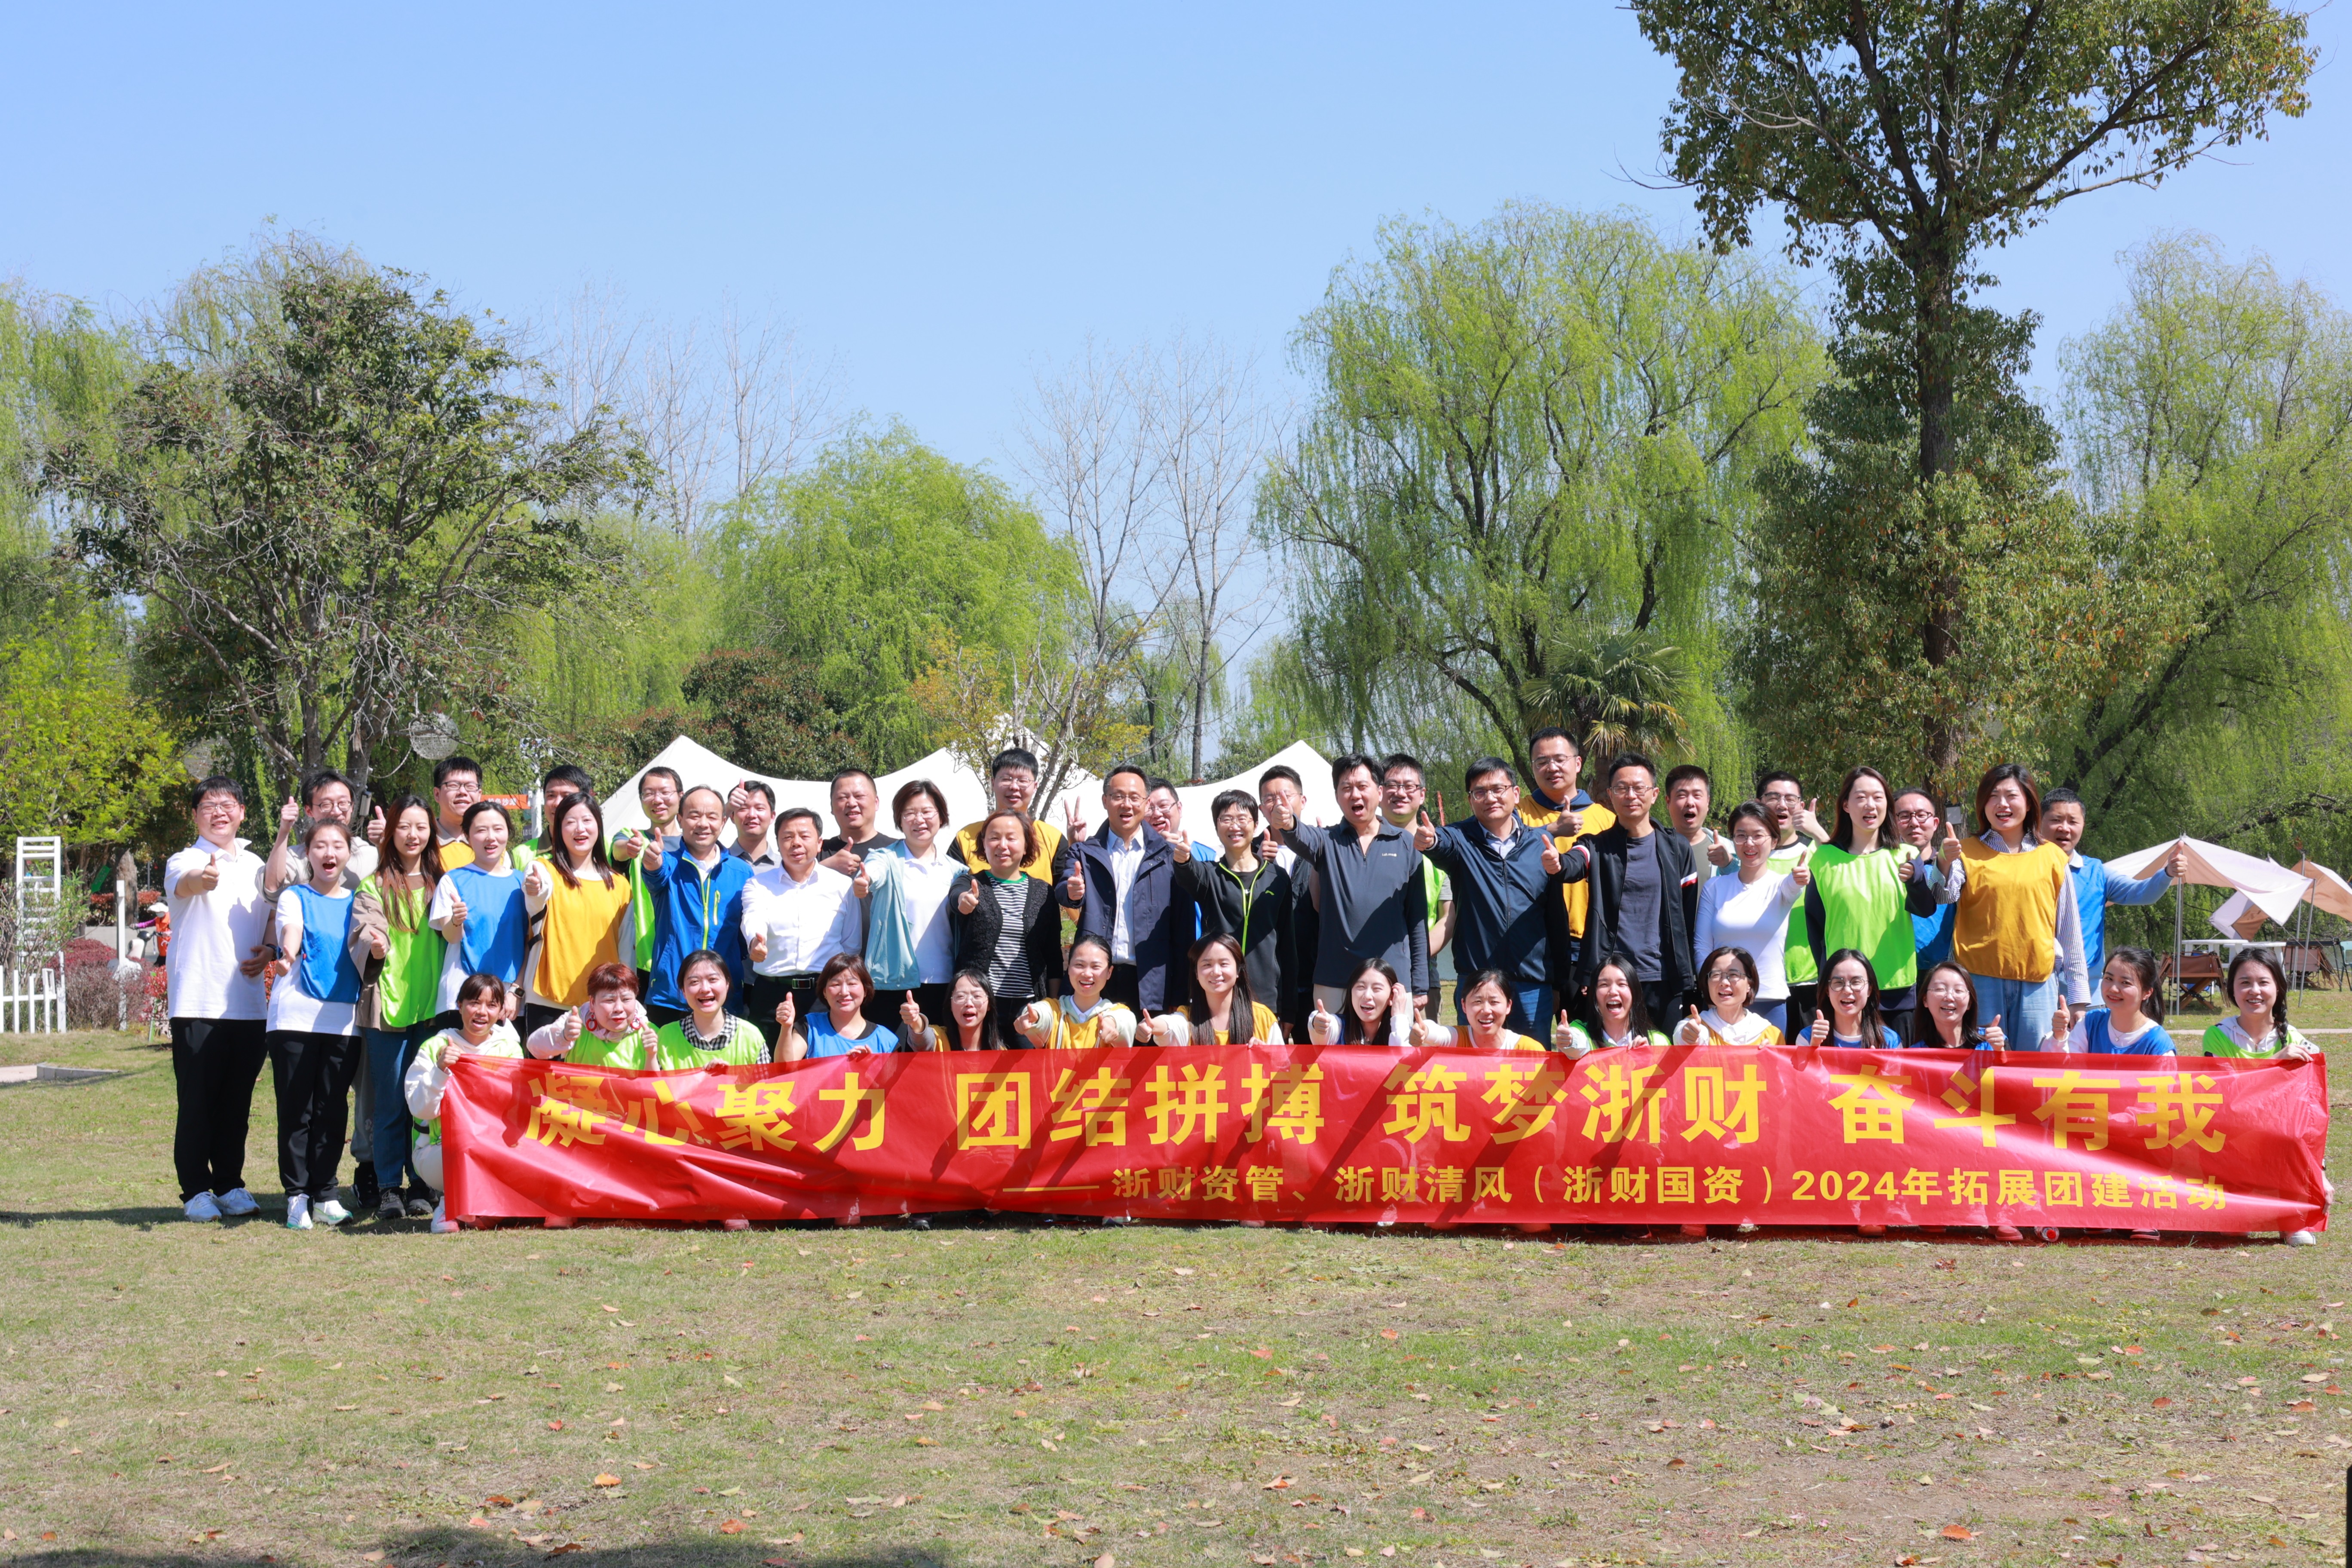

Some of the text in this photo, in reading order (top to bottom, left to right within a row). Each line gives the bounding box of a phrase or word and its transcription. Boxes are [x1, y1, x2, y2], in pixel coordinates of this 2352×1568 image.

[524, 1063, 2226, 1153] 凝心聚力 团结拼搏 筑梦浙财 奋斗有我
